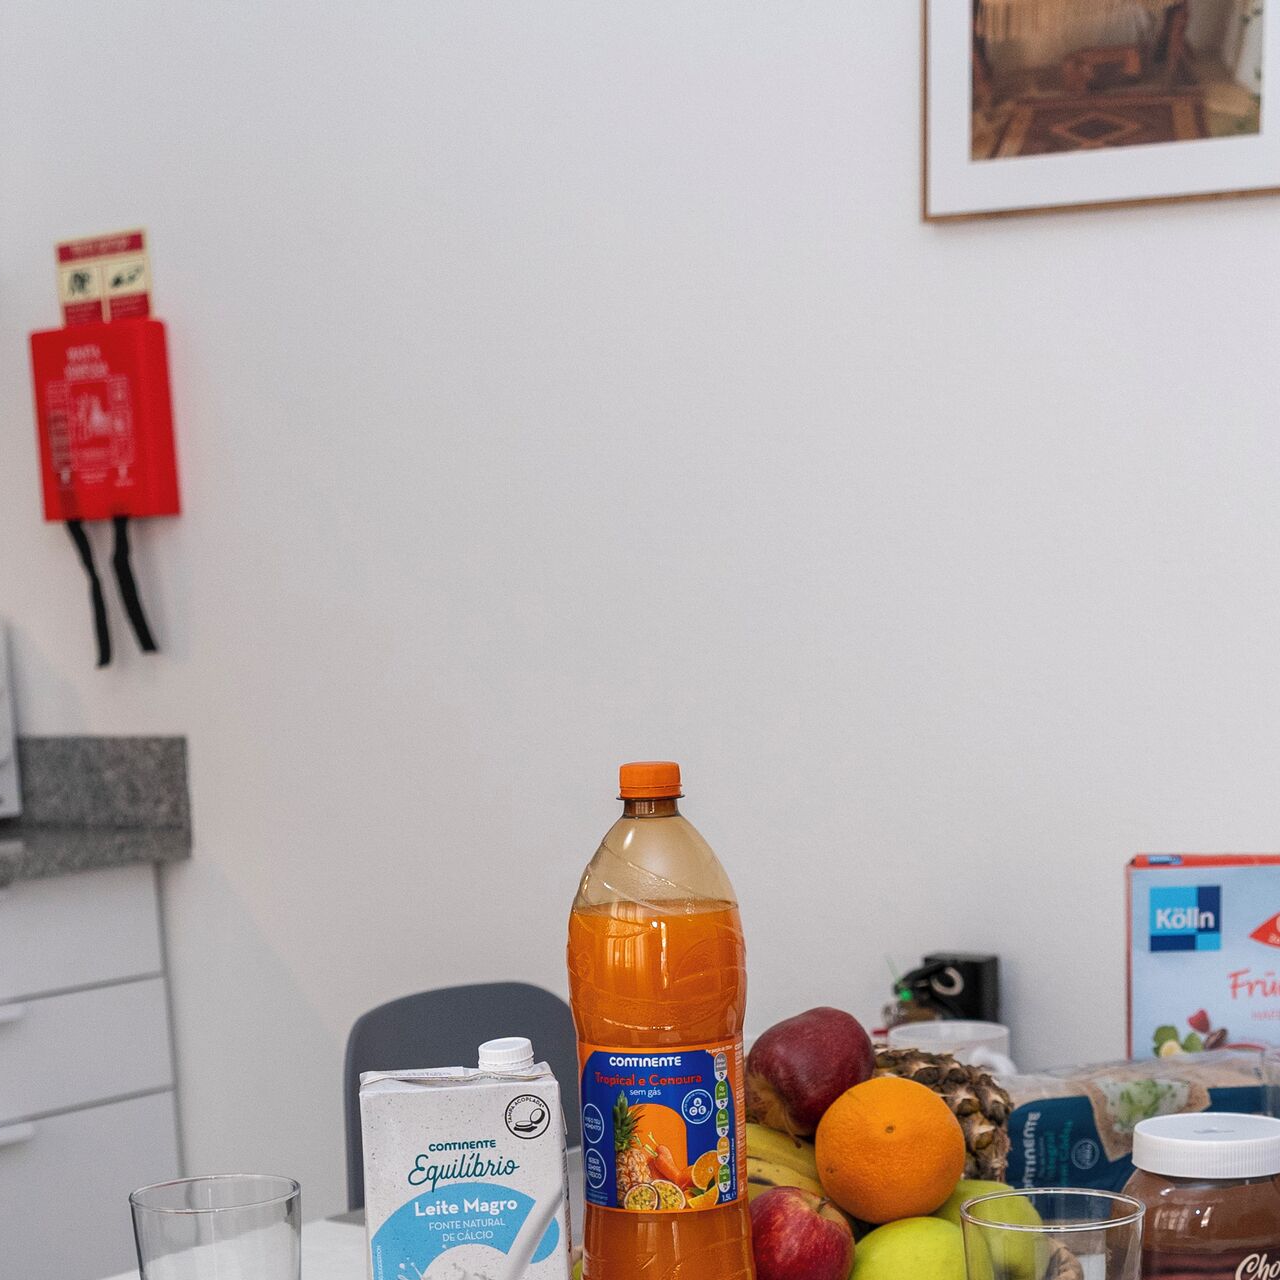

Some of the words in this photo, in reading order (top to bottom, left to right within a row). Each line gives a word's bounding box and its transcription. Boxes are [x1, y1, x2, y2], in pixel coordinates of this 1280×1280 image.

[1155, 906, 1215, 929] Kölln
[609, 1056, 682, 1067] CONTINENTE
[594, 1071, 635, 1087] Tropical
[638, 1077, 646, 1086] e
[647, 1087, 662, 1098] gás
[428, 1139, 497, 1152] CONTINENTE
[408, 1152, 520, 1192] Equilíbrio
[415, 1201, 459, 1217] Leite
[464, 1199, 518, 1216] Magro
[429, 1220, 461, 1231] FONTE
[463, 1218, 506, 1229] NATURAL
[442, 1233, 455, 1242] DE
[457, 1229, 494, 1241] CÁLCIO
